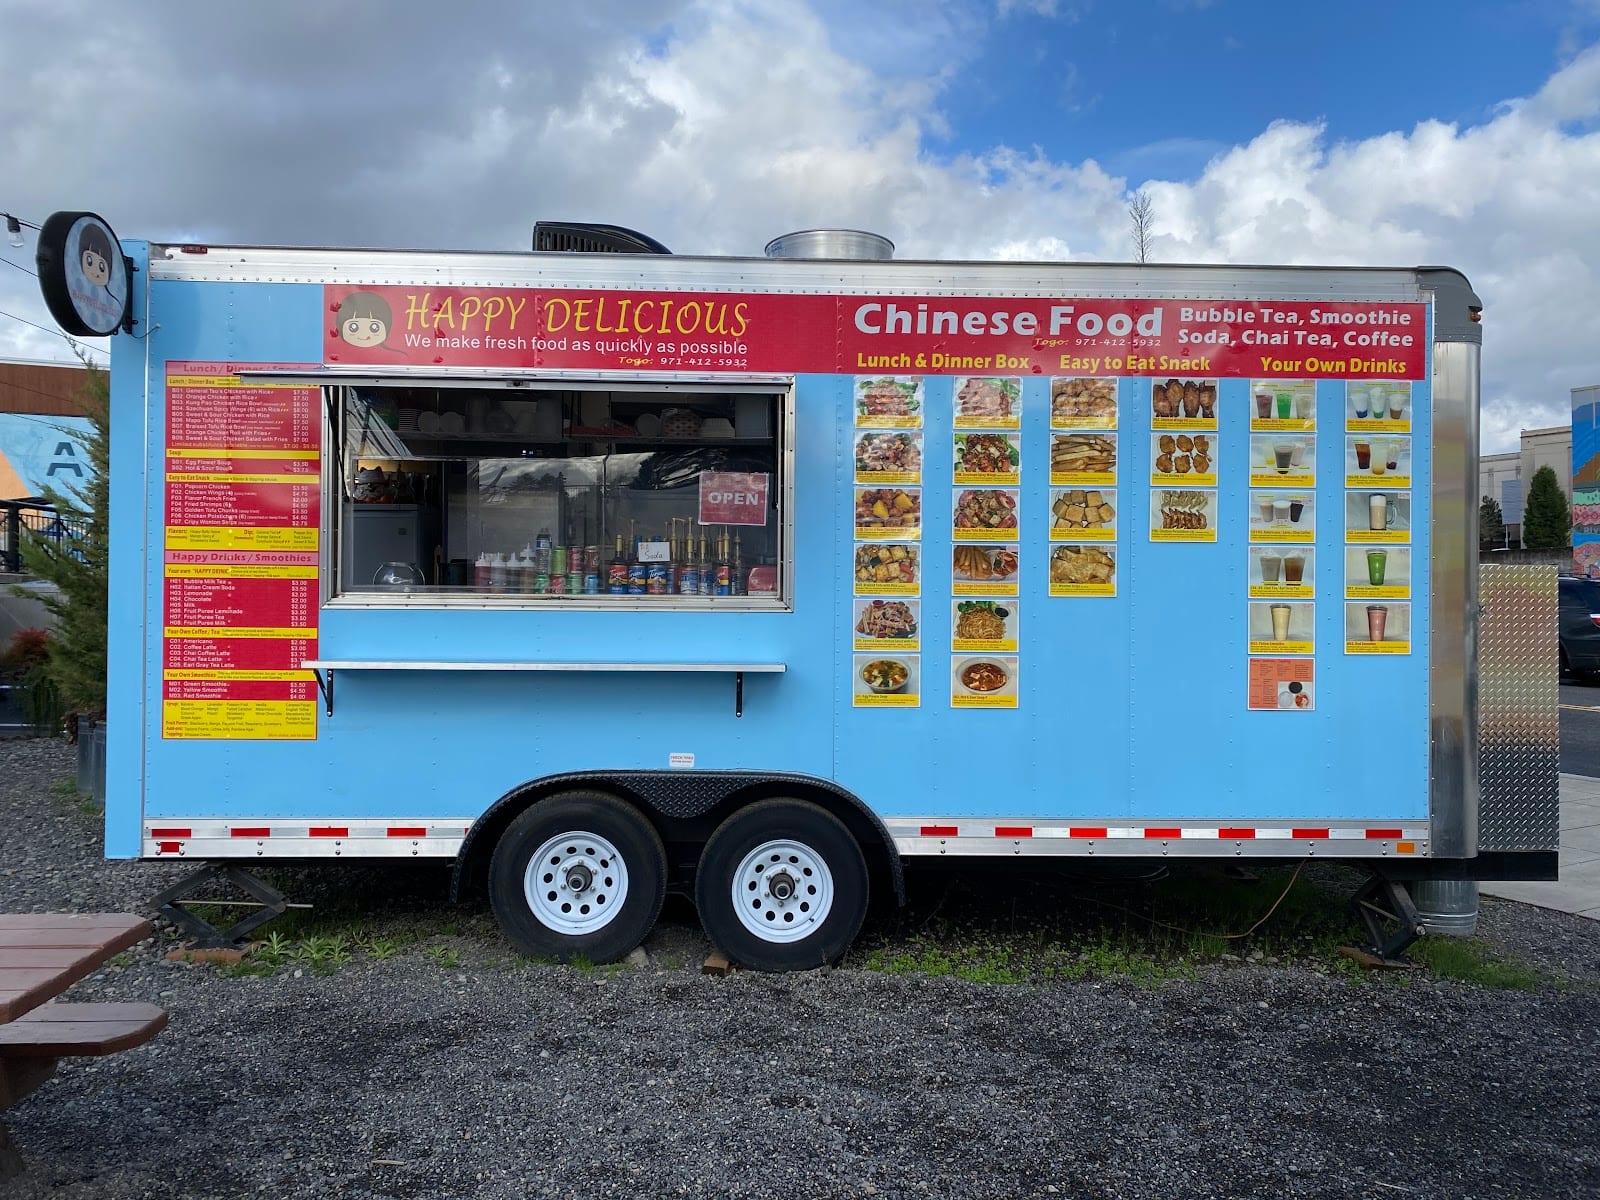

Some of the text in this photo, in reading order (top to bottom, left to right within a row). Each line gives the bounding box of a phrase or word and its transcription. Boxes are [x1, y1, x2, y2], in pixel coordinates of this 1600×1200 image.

[405, 293, 748, 337] HAPPY DELICIOUS
[855, 303, 1163, 337] Chinese Food
[1180, 308, 1412, 326] Bubble Tea, Smoothie
[404, 334, 748, 357] We make fresh food as quickly as possible
[1075, 338, 1161, 347] 971-412-5932
[1178, 330, 1414, 350] Soda, Chai Tea, Coffee
[184, 364, 217, 372] Lunch
[619, 356, 748, 367] Togo: 971-412-5932
[857, 353, 1031, 370] Lunch & Dinner Box
[1059, 355, 1211, 374] Easy to Eat Snack
[1260, 357, 1407, 375] Your Own Drinks
[707, 491, 759, 506] OPEN
[172, 553, 208, 563] Happy
[210, 553, 245, 561] Drinks
[255, 554, 311, 562] Smoothies
